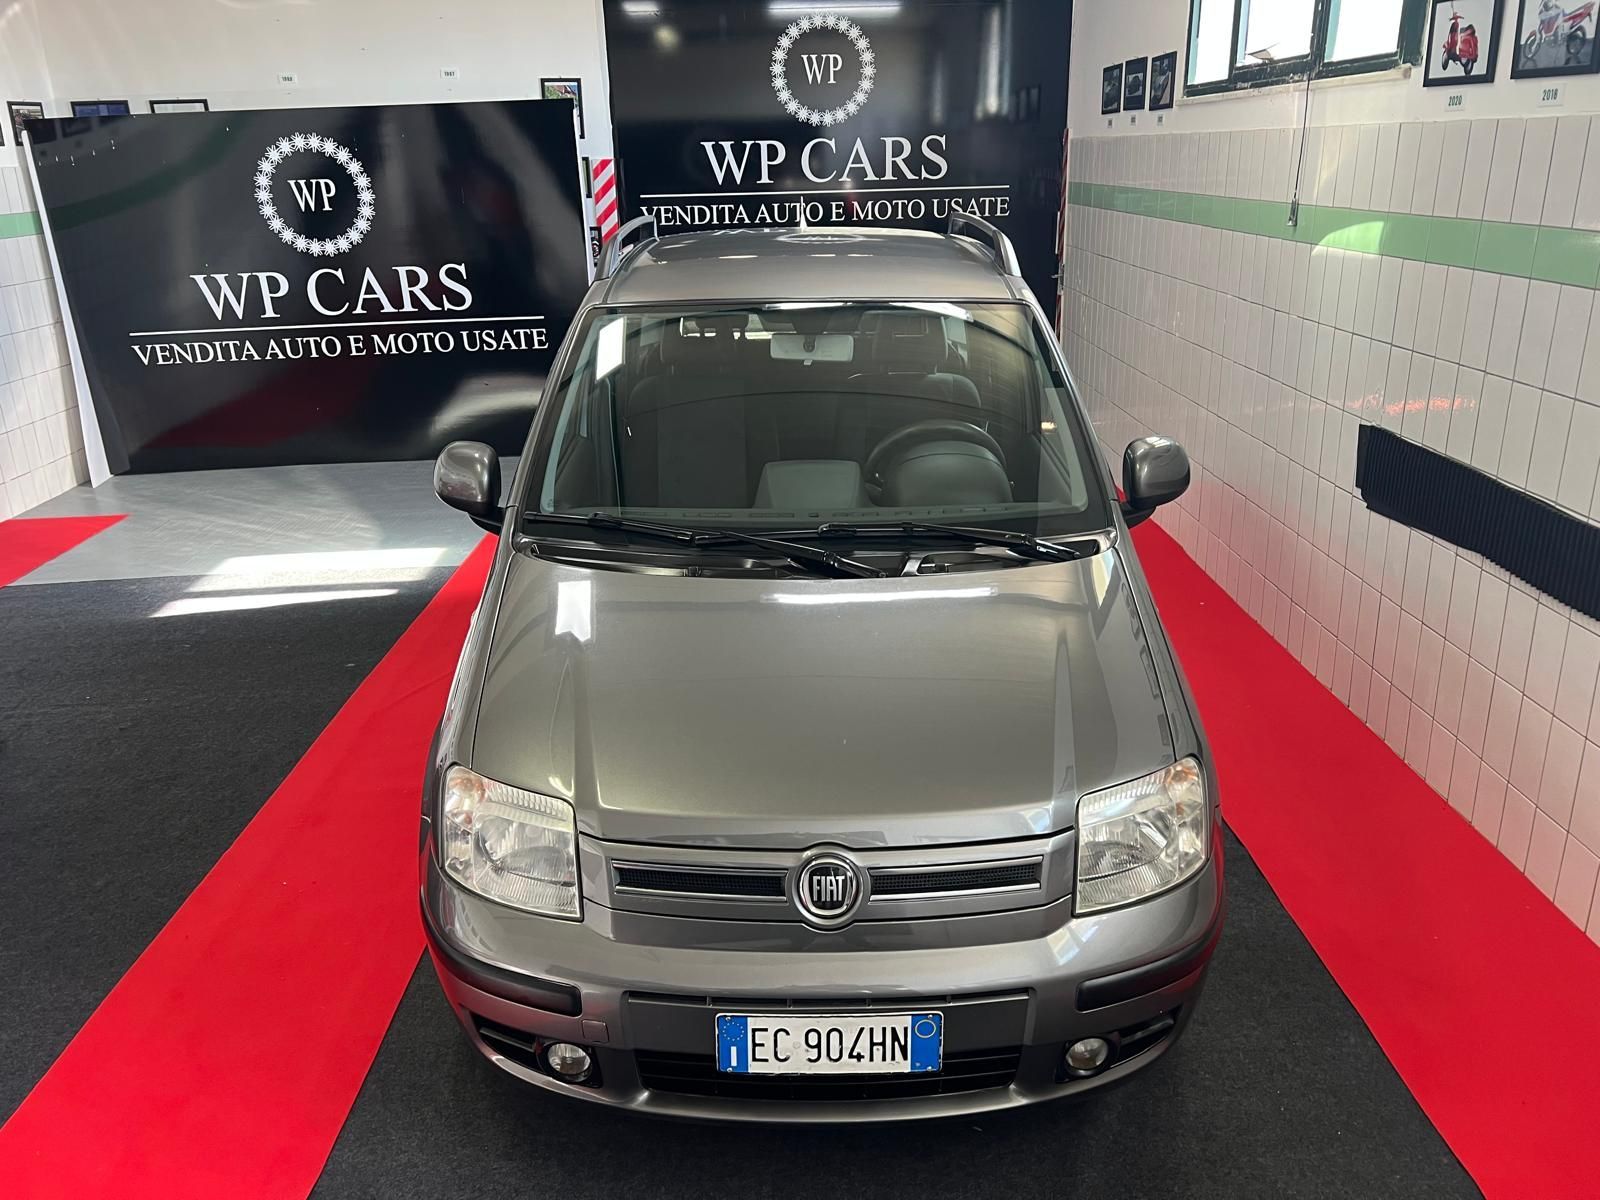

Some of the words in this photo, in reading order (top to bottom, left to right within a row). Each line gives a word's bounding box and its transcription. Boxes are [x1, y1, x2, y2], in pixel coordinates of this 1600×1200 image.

[801, 54, 843, 85] WP
[701, 141, 786, 185] WP
[801, 135, 948, 182] CARS
[288, 179, 336, 212] WP
[755, 202, 823, 224] AUTO
[830, 202, 845, 222] E
[852, 199, 925, 221] MOTO
[932, 197, 1010, 219] USATE
[190, 272, 290, 320] WP
[306, 263, 473, 315] CARS
[131, 340, 261, 366] VENDITA
[265, 336, 341, 361] AUTO
[347, 336, 366, 356] E
[371, 332, 454, 355] MOTO
[460, 329, 549, 352] USATE
[812, 875, 846, 902] FIAT
[751, 1027, 791, 1063] EC
[804, 1026, 909, 1063] 904HN
